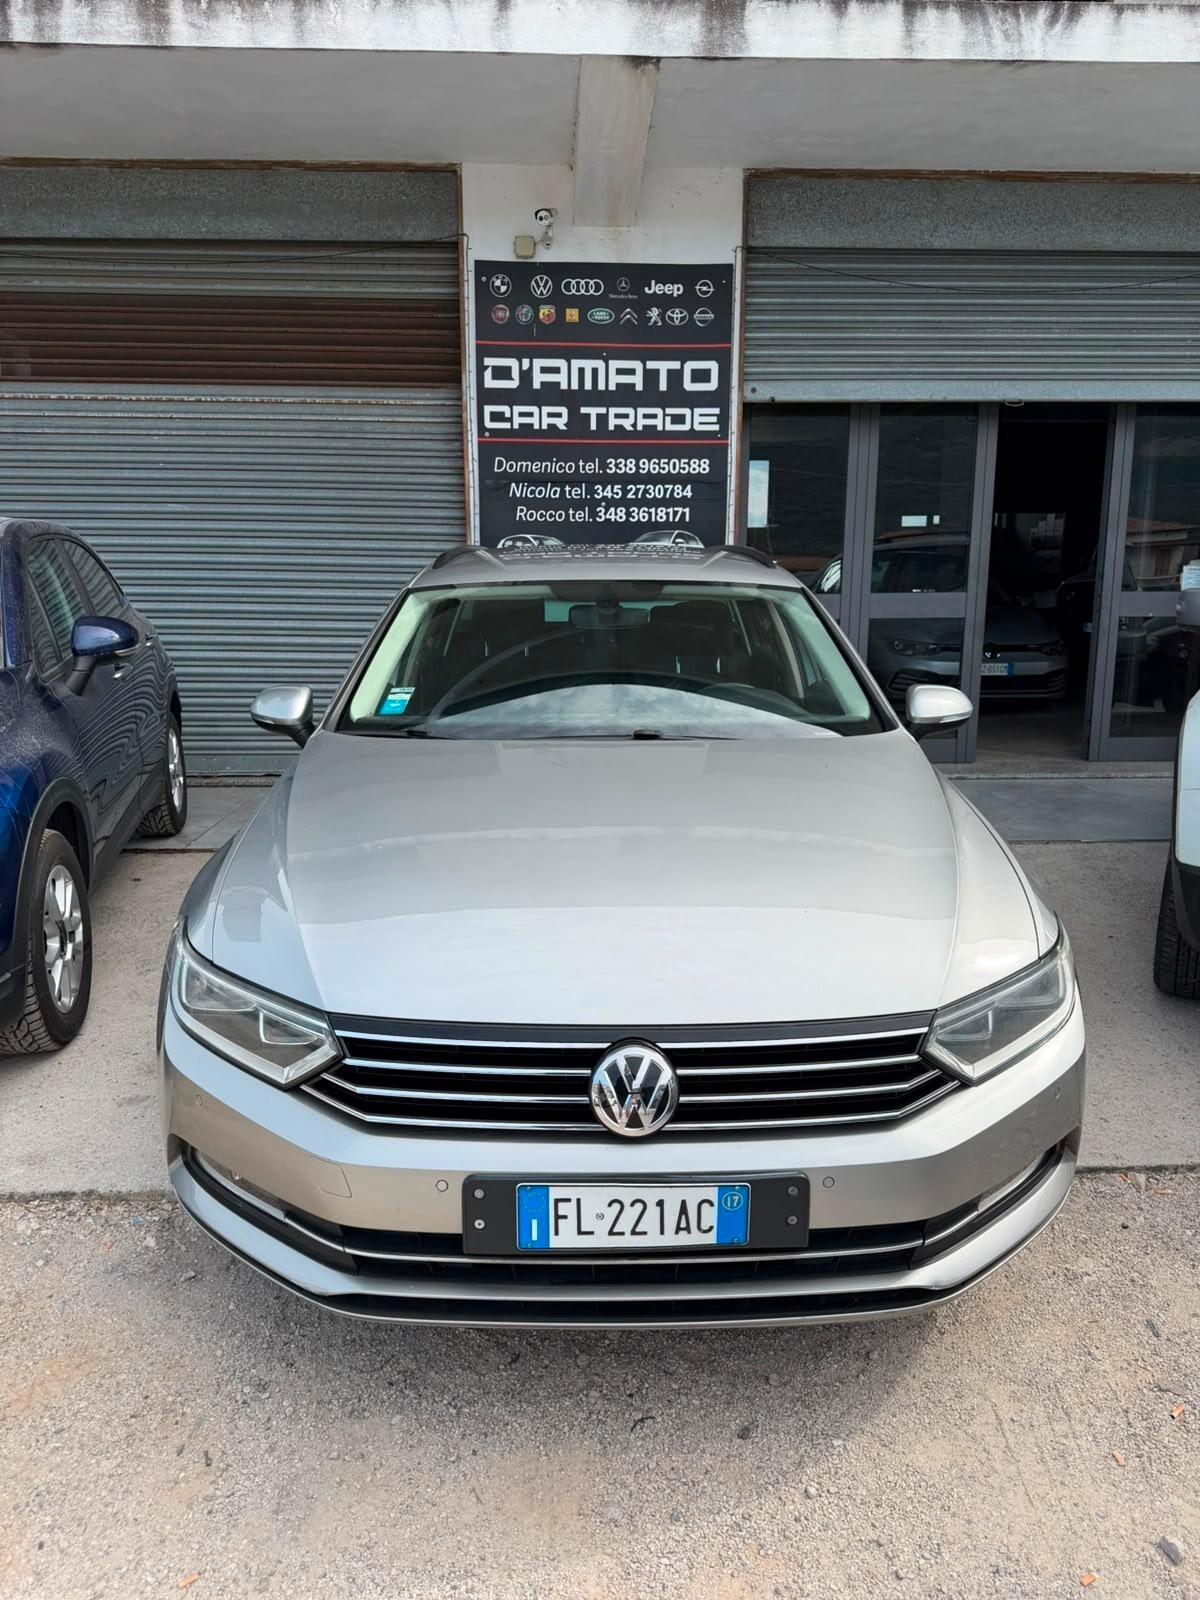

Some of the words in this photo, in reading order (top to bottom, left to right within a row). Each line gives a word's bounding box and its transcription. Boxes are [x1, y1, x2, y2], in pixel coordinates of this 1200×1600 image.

[644, 279, 684, 297] Jeep
[483, 357, 719, 392] D'AMATO
[483, 404, 568, 431] CAR
[580, 406, 720, 432] TRADE
[494, 456, 575, 474] Domenico
[578, 458, 603, 474] tel.
[606, 459, 637, 474] 338
[639, 459, 710, 474] 9650588
[509, 482, 561, 499] Nicola
[564, 483, 590, 499] tel.
[594, 484, 622, 499] 345
[627, 484, 692, 499] 2730784
[516, 506, 565, 522] Rocco
[568, 507, 593, 522] tel.
[596, 507, 628, 522] 348
[629, 507, 690, 522] 3618171
